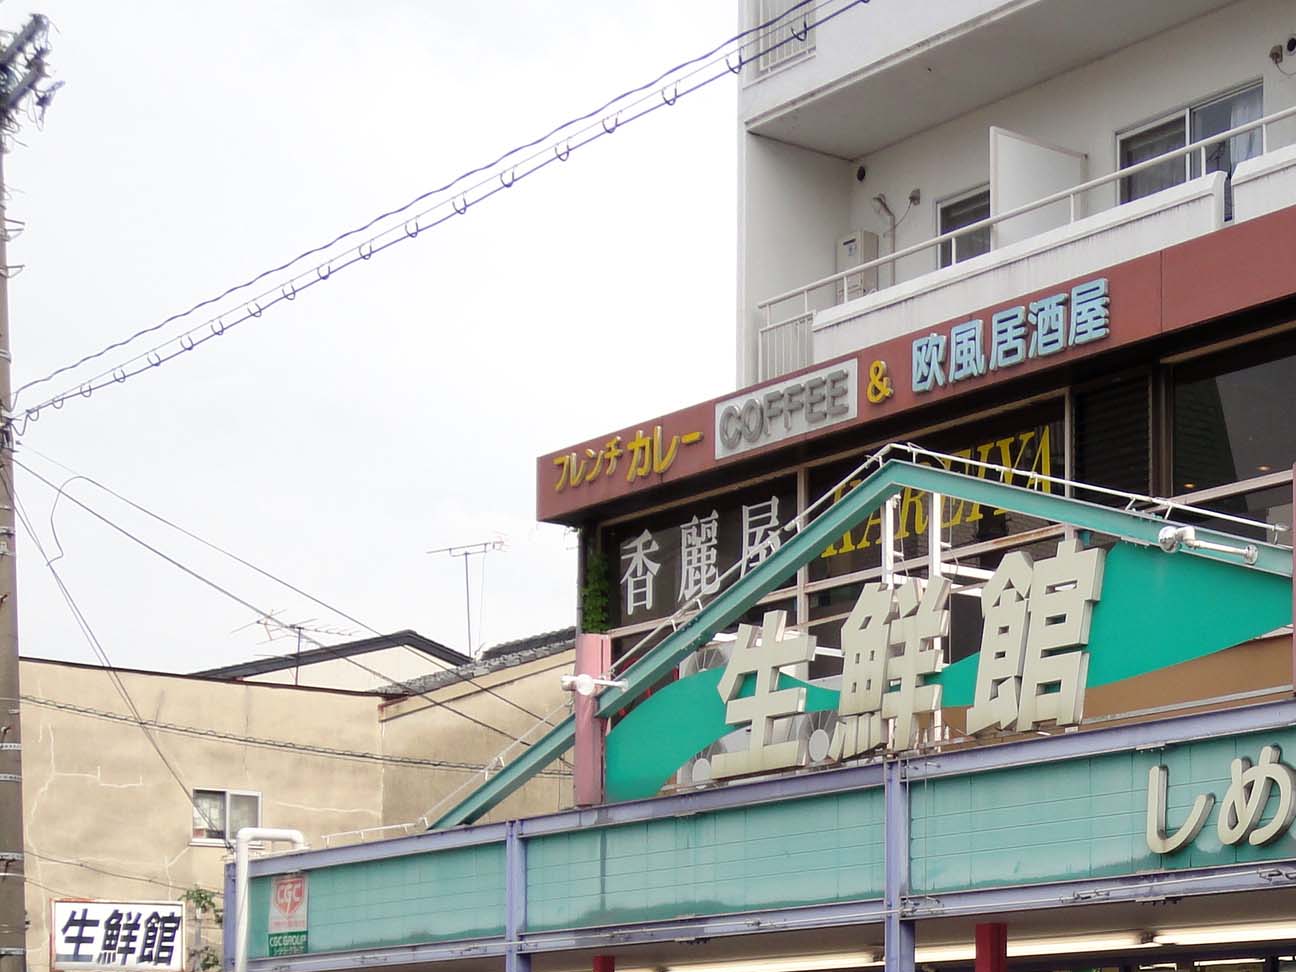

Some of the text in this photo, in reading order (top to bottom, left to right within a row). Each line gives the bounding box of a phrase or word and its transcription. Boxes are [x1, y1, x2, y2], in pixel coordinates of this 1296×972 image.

[553, 278, 1109, 491] フレンチカレー COFFEE & 欧風居酒屋
[620, 496, 781, 615] 香麗屋
[711, 540, 1107, 779] 生鮮館
[56, 908, 182, 966] 生鮮館
[277, 882, 303, 908] CGC
